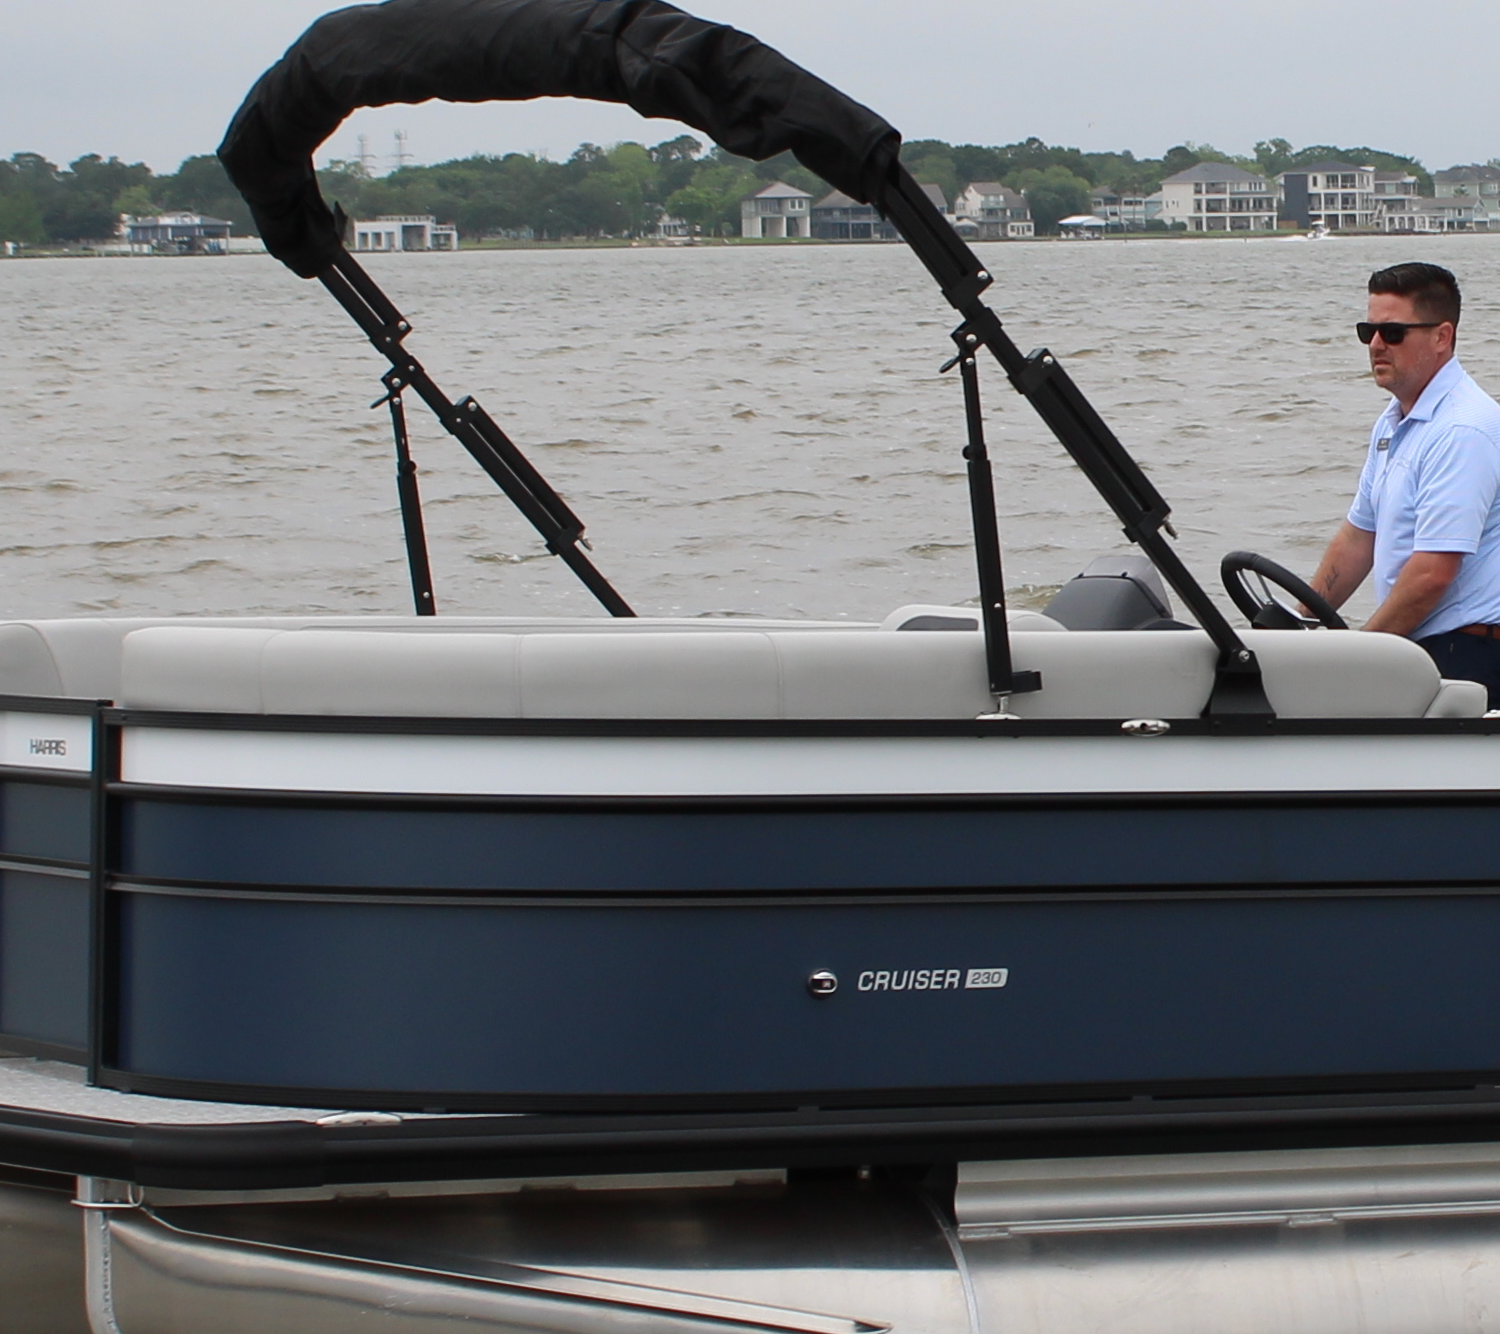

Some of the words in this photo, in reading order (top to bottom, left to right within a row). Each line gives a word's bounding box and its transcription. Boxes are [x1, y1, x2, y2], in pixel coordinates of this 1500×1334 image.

[29, 739, 67, 756] HARRIS
[857, 970, 961, 991] CRUISER
[970, 971, 1001, 985] 230
